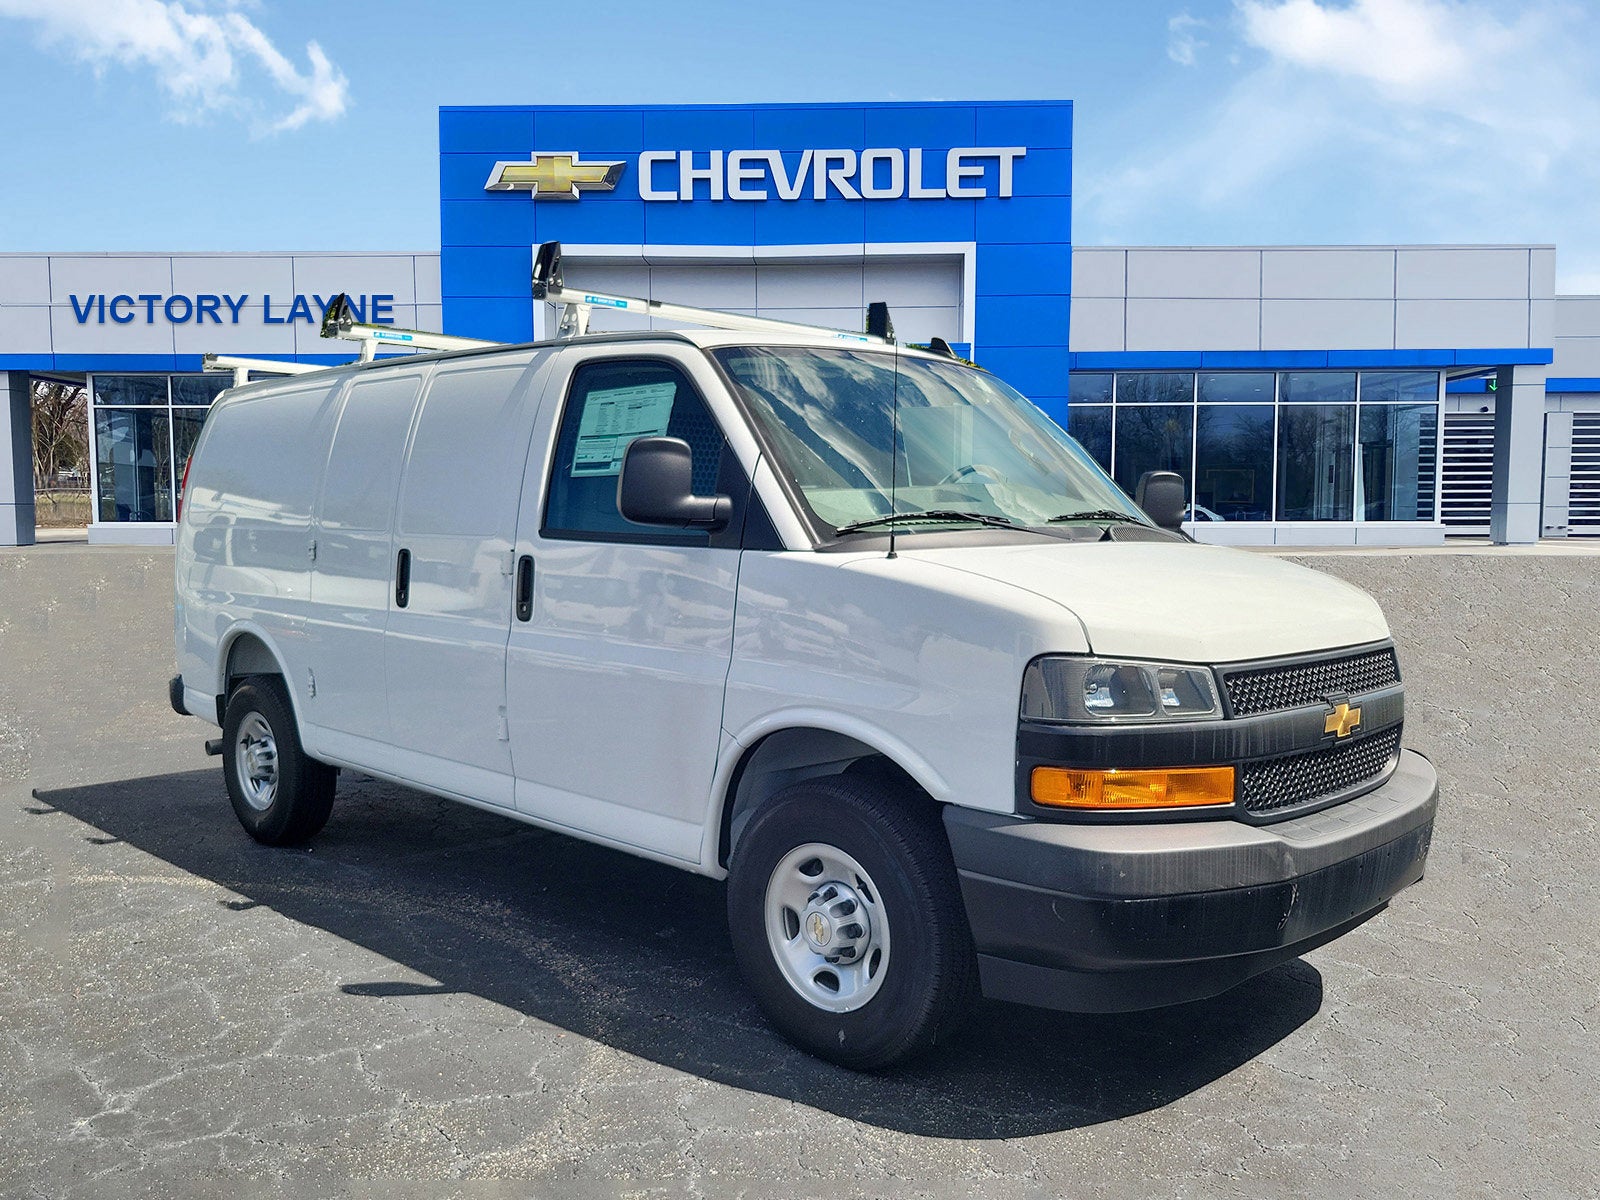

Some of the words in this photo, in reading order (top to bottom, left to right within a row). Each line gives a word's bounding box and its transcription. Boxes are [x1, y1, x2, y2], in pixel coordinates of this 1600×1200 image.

[638, 147, 1027, 201] CHEVROLET
[69, 294, 249, 324] VICTORY
[264, 294, 395, 324] LAYNE
